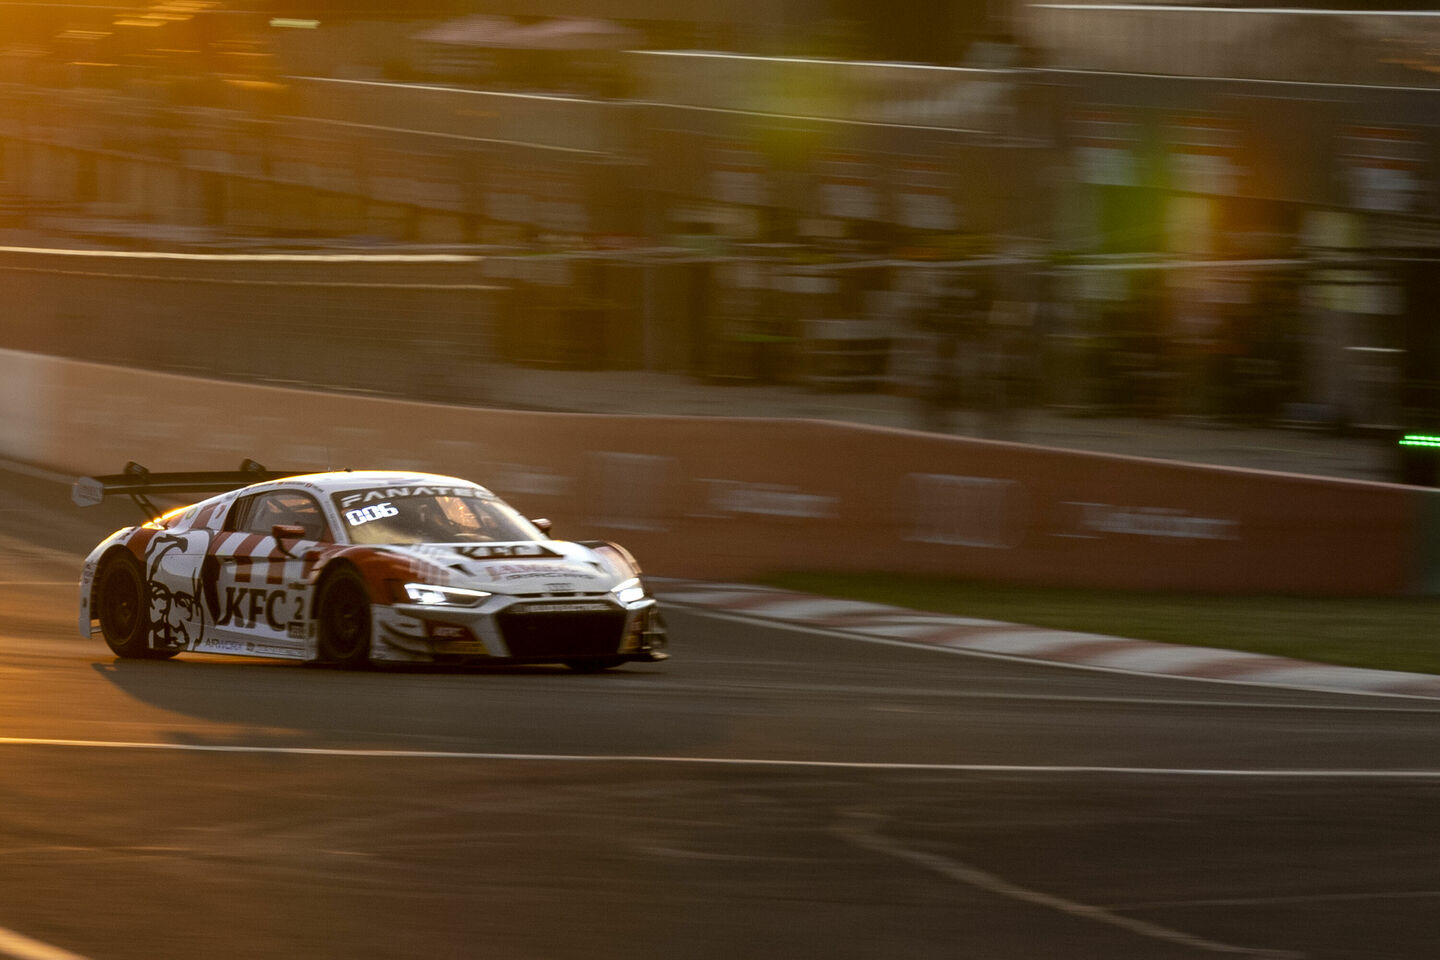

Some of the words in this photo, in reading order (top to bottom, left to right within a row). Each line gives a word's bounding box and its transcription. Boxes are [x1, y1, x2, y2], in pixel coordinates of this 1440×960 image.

[341, 487, 498, 508] FANATEC
[216, 587, 287, 632] KFC
[294, 596, 304, 620] 2
